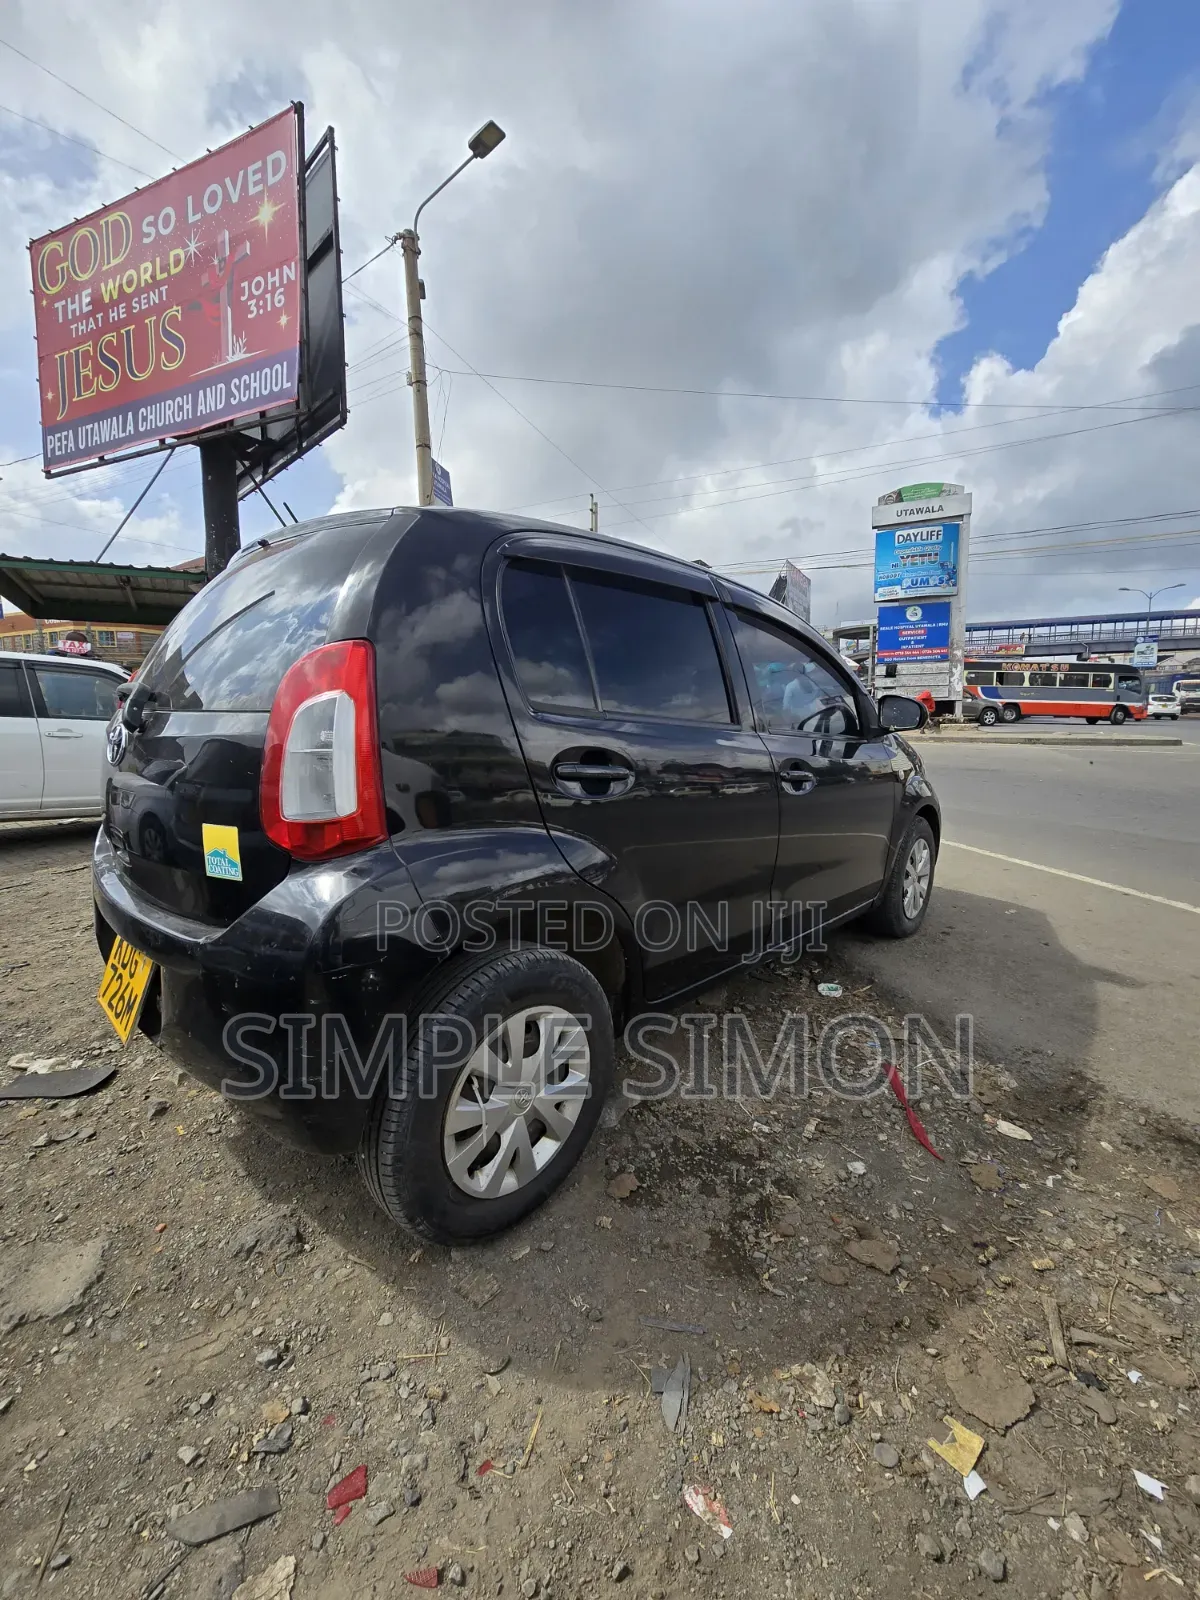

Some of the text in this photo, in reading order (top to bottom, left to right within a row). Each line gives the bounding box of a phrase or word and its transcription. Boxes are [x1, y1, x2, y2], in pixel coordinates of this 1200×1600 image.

[38, 150, 287, 295] GOD SO LOVED
[54, 248, 186, 324] THE WORLD
[240, 261, 296, 301] JOHN
[70, 285, 169, 338] THAT HE SENT
[247, 288, 285, 319] 3:16
[55, 307, 187, 421] JESUS
[47, 361, 291, 458] PEFA UTAWALA CHURCH AND SCHOOL
[896, 504, 944, 517] UTAWALA
[897, 530, 942, 544] DAYLIFF
[899, 551, 939, 568] YETU
[207, 856, 229, 867] TOTAL
[208, 865, 239, 877] COATING
[102, 962, 138, 1032] 726M
